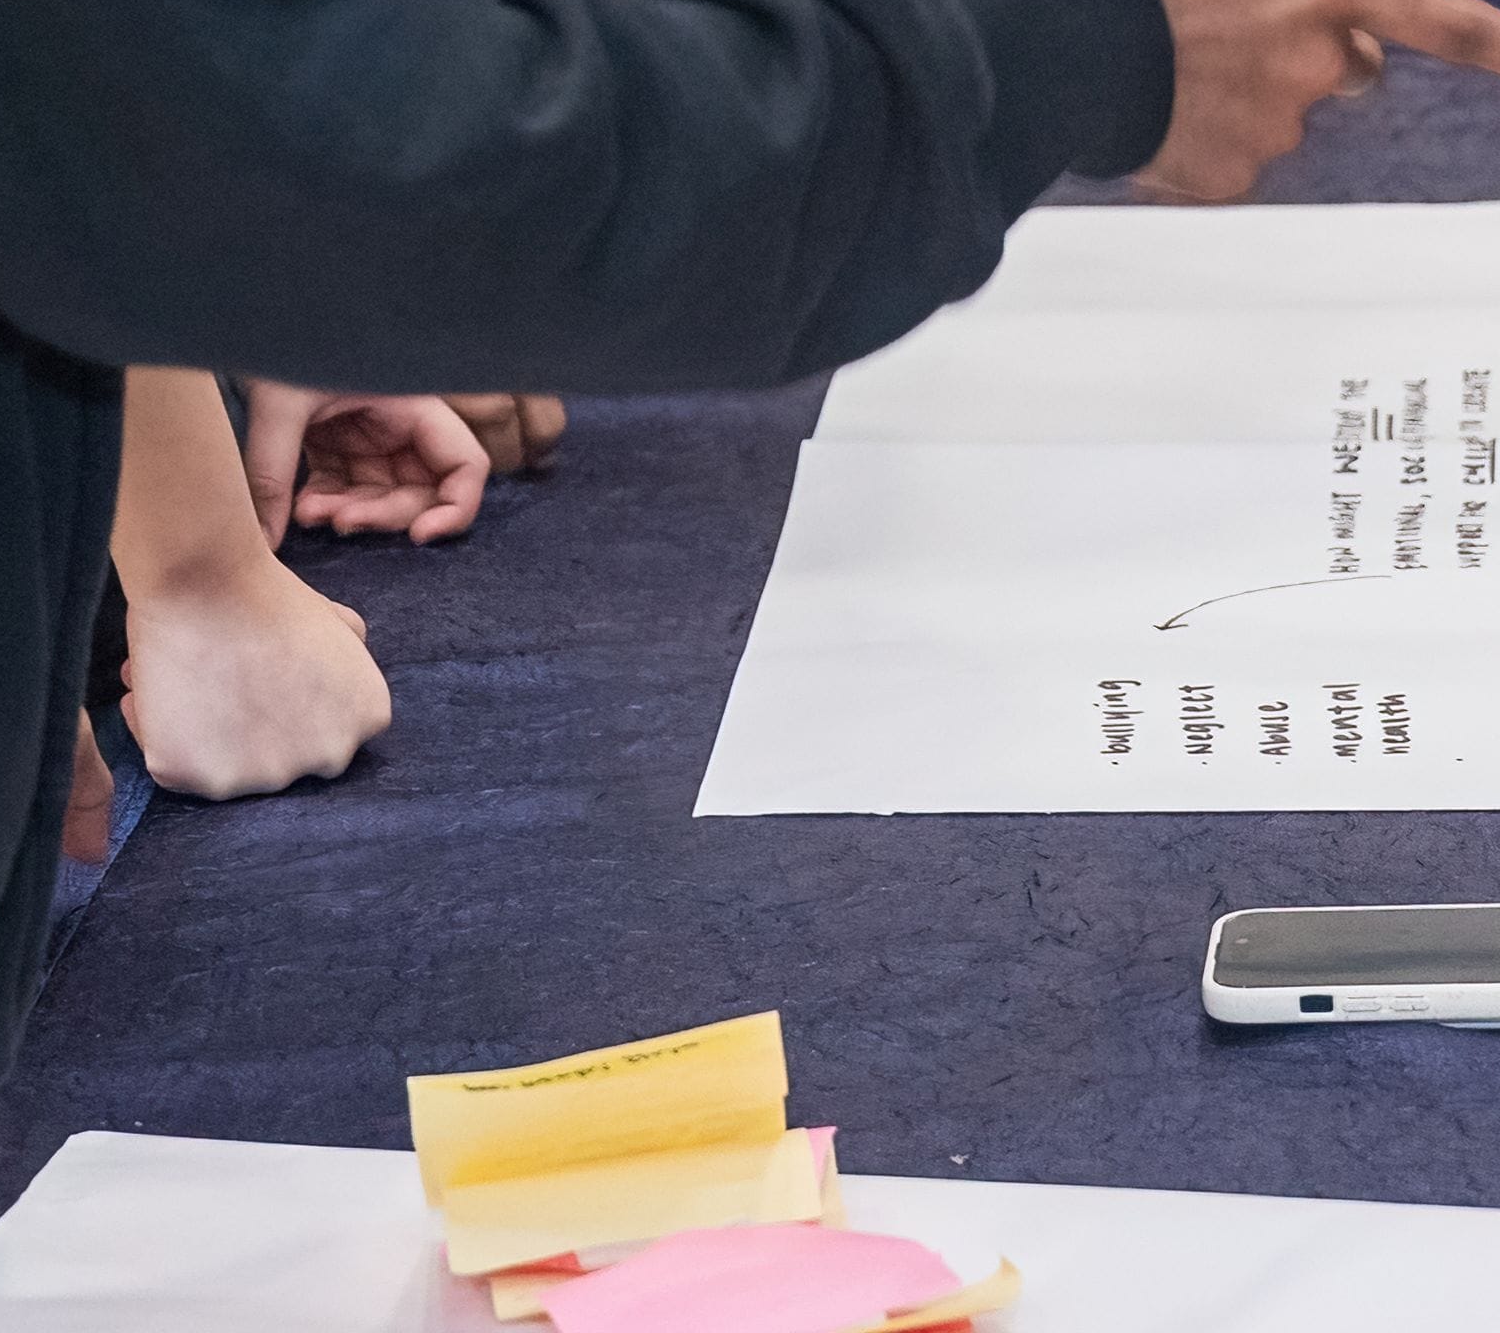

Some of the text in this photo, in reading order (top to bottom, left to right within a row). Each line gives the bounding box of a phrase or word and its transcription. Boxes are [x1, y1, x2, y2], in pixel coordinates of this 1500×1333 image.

[1093, 679, 1145, 755] bullying
[1178, 684, 1225, 755] Neglect
[1258, 700, 1293, 756] Abuse
[1322, 683, 1364, 758] mental
[1376, 693, 1412, 755] health
